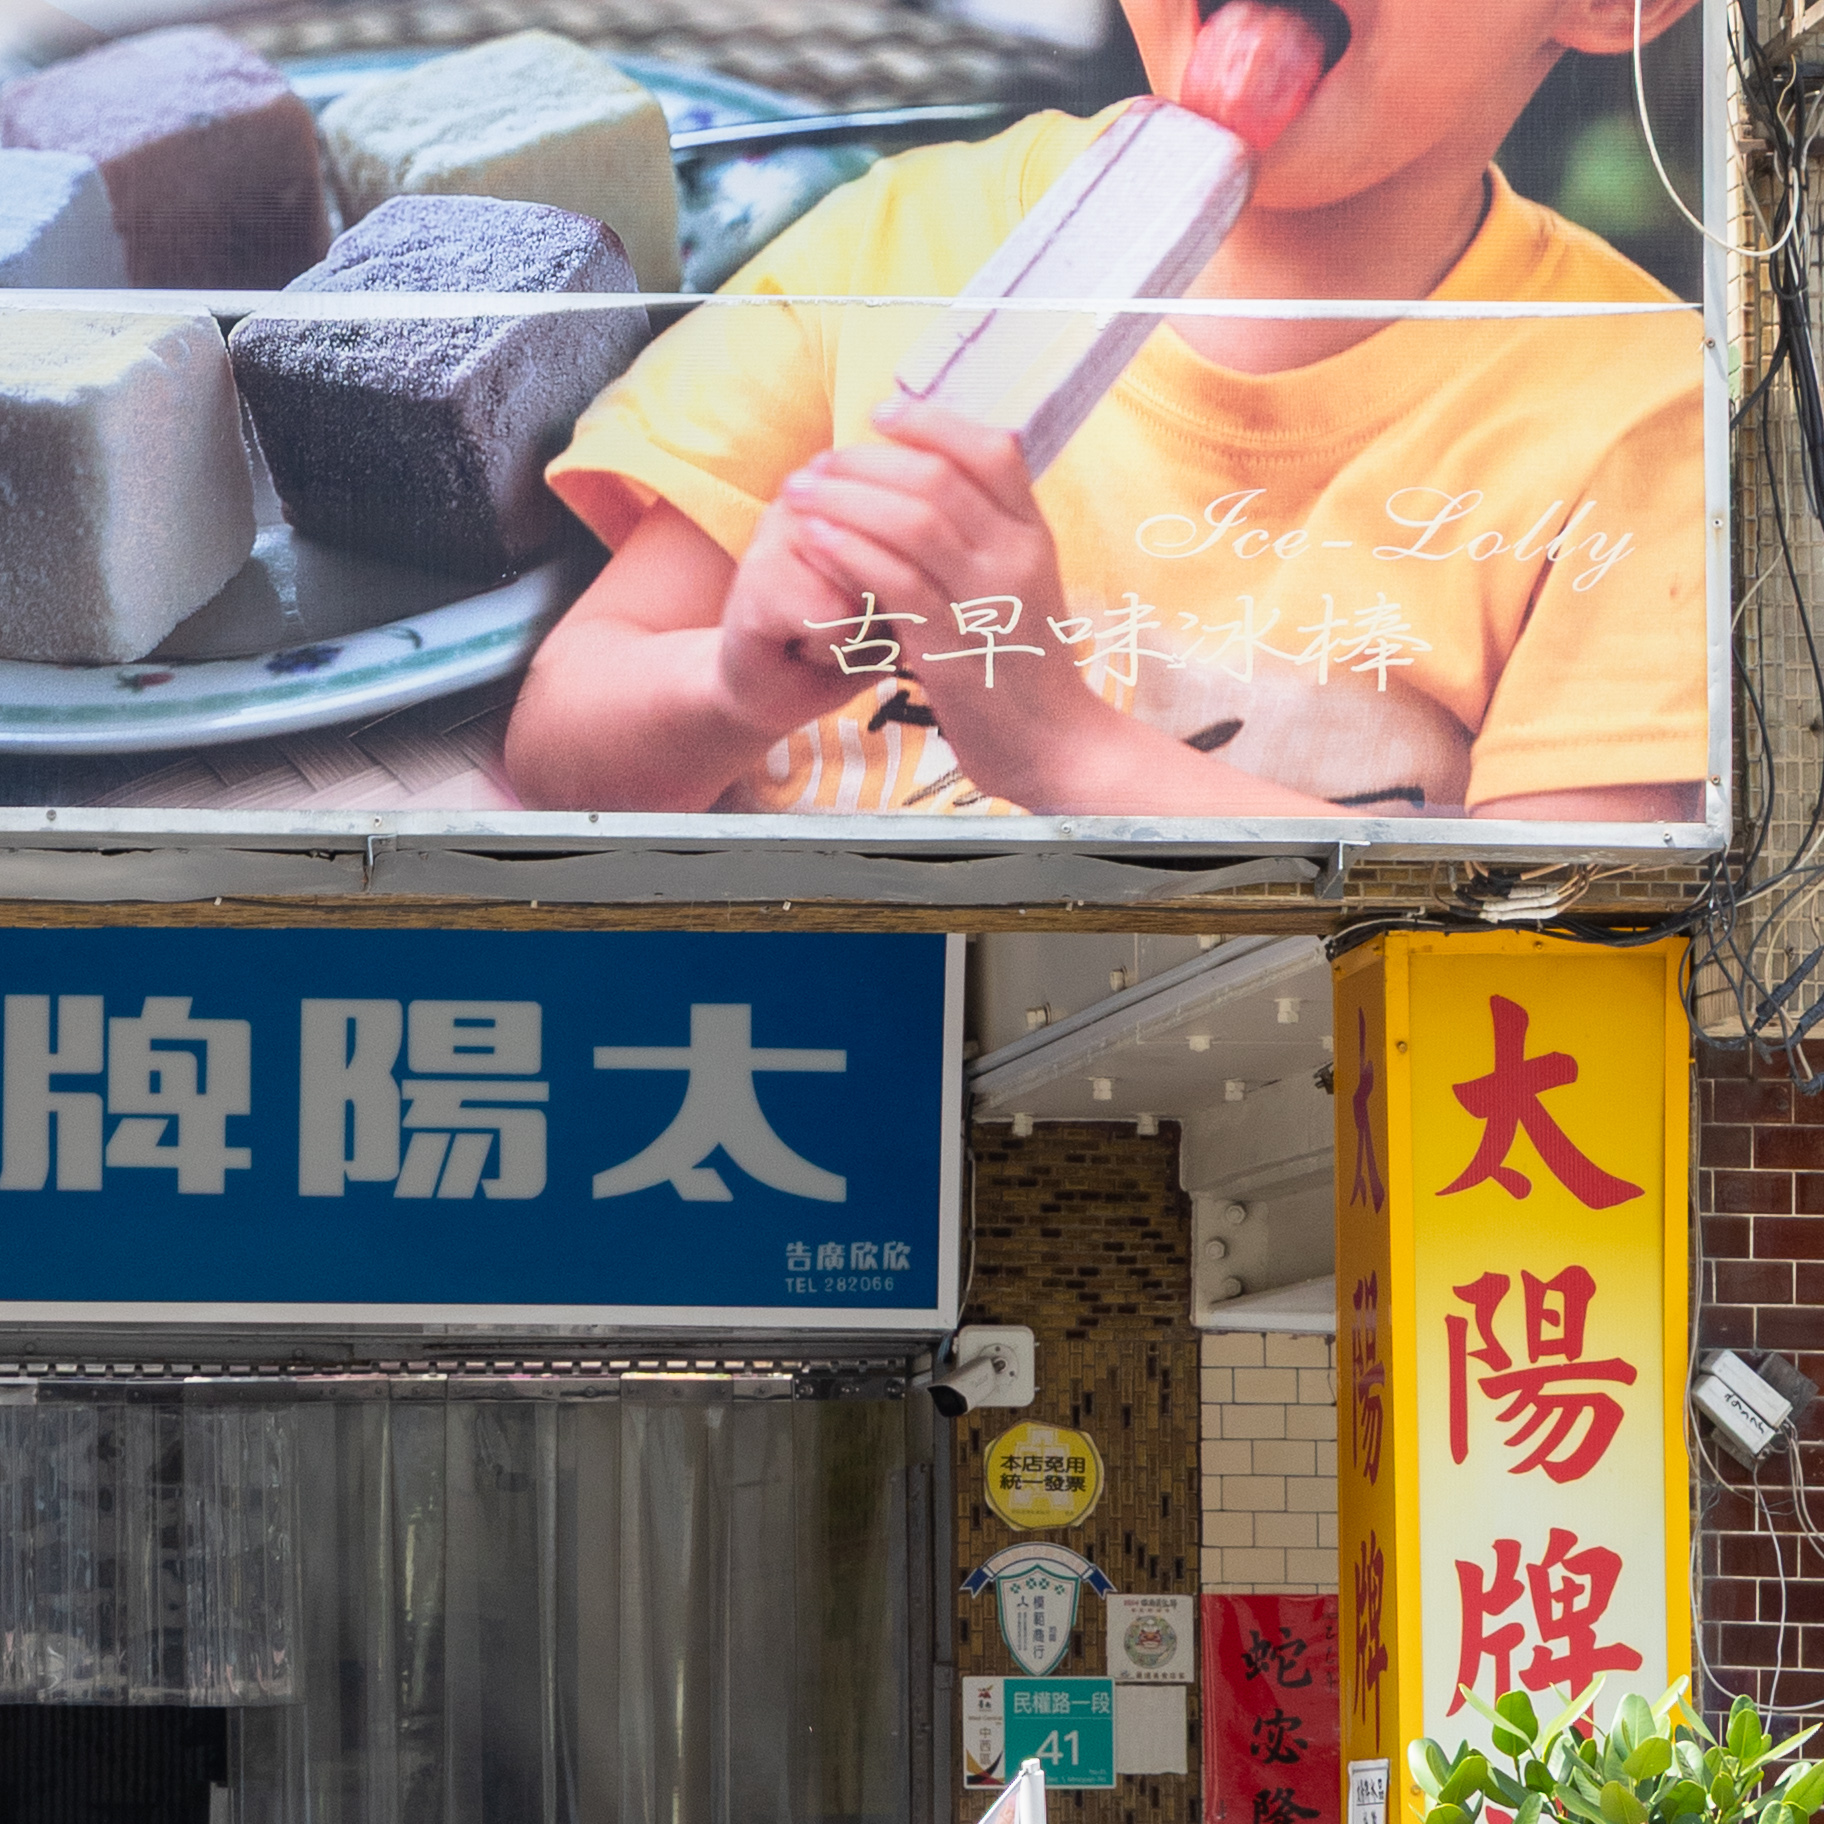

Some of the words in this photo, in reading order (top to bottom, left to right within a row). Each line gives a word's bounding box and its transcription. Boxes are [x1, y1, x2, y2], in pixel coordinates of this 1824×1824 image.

[1135, 486, 1636, 591] Ice-Lolly
[803, 591, 1432, 690] 古早味冰棒
[785, 1277, 817, 1294] TEL
[824, 1277, 894, 1292] 282066
[1000, 1455, 1086, 1474] 本店免用
[1000, 1474, 1086, 1493] 統一發票
[1014, 1692, 1111, 1715] 民權路一段
[979, 1727, 992, 1766] 中西區
[1036, 1729, 1080, 1766] 41
